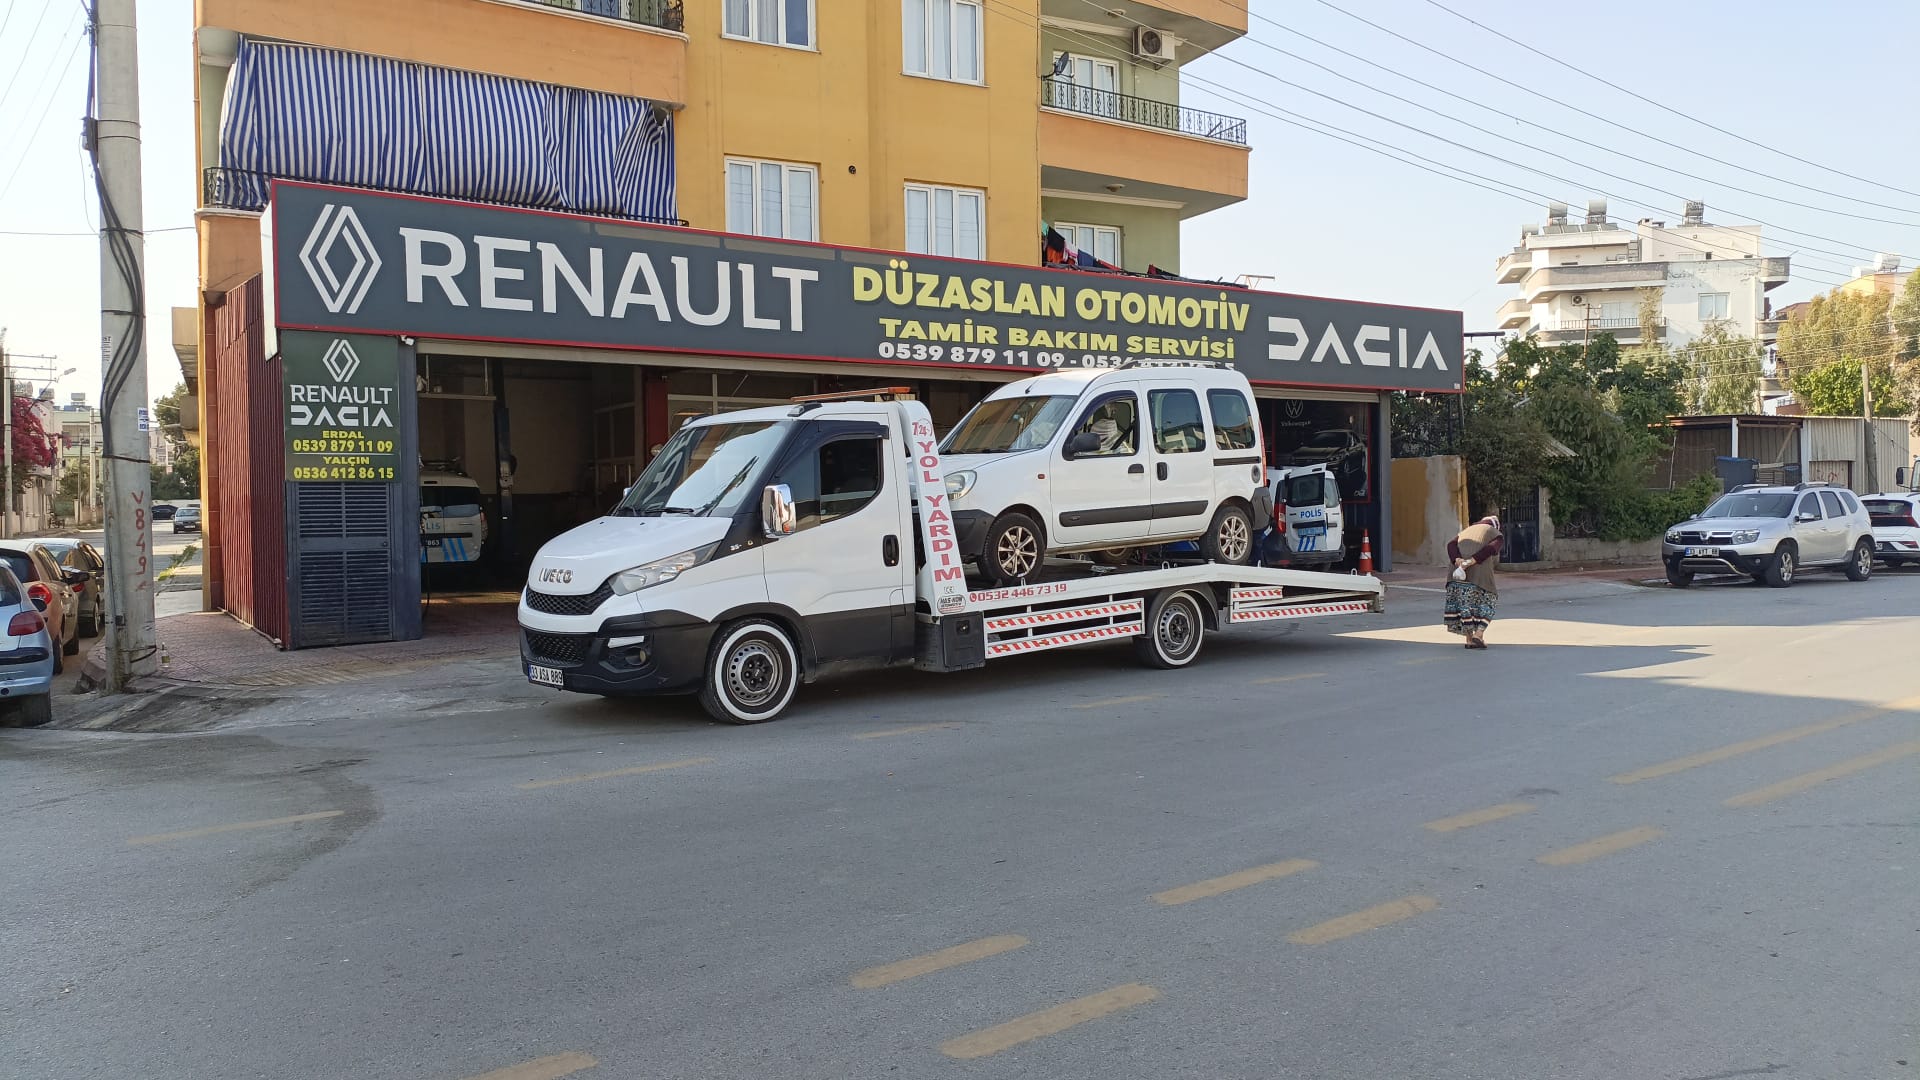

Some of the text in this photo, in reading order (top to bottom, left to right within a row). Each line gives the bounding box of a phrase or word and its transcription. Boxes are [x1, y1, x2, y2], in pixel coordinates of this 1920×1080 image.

[399, 227, 820, 333] RENAULT
[853, 258, 1250, 332] DÜZASLAN OTOMOTİV
[879, 318, 1235, 359] TAMİR BAKIM SERVİSİ
[1268, 316, 1449, 371] DACIA
[878, 342, 944, 361] 0539
[950, 346, 996, 364] 879
[1002, 349, 1029, 366] 11
[1036, 351, 1065, 367] 09
[290, 384, 393, 405] RENAULT
[290, 405, 394, 428] DACIA
[322, 430, 365, 439] ERDAL
[293, 440, 393, 453] 0539 879 11 09
[323, 456, 370, 467] YALÇIN
[917, 440, 940, 483] YOL
[293, 467, 394, 479] 0536 412 86 15
[925, 494, 962, 582] YARDIM
[538, 568, 573, 584] IVECO
[978, 583, 1067, 601] 0532 446 73 19
[531, 666, 538, 679] 33
